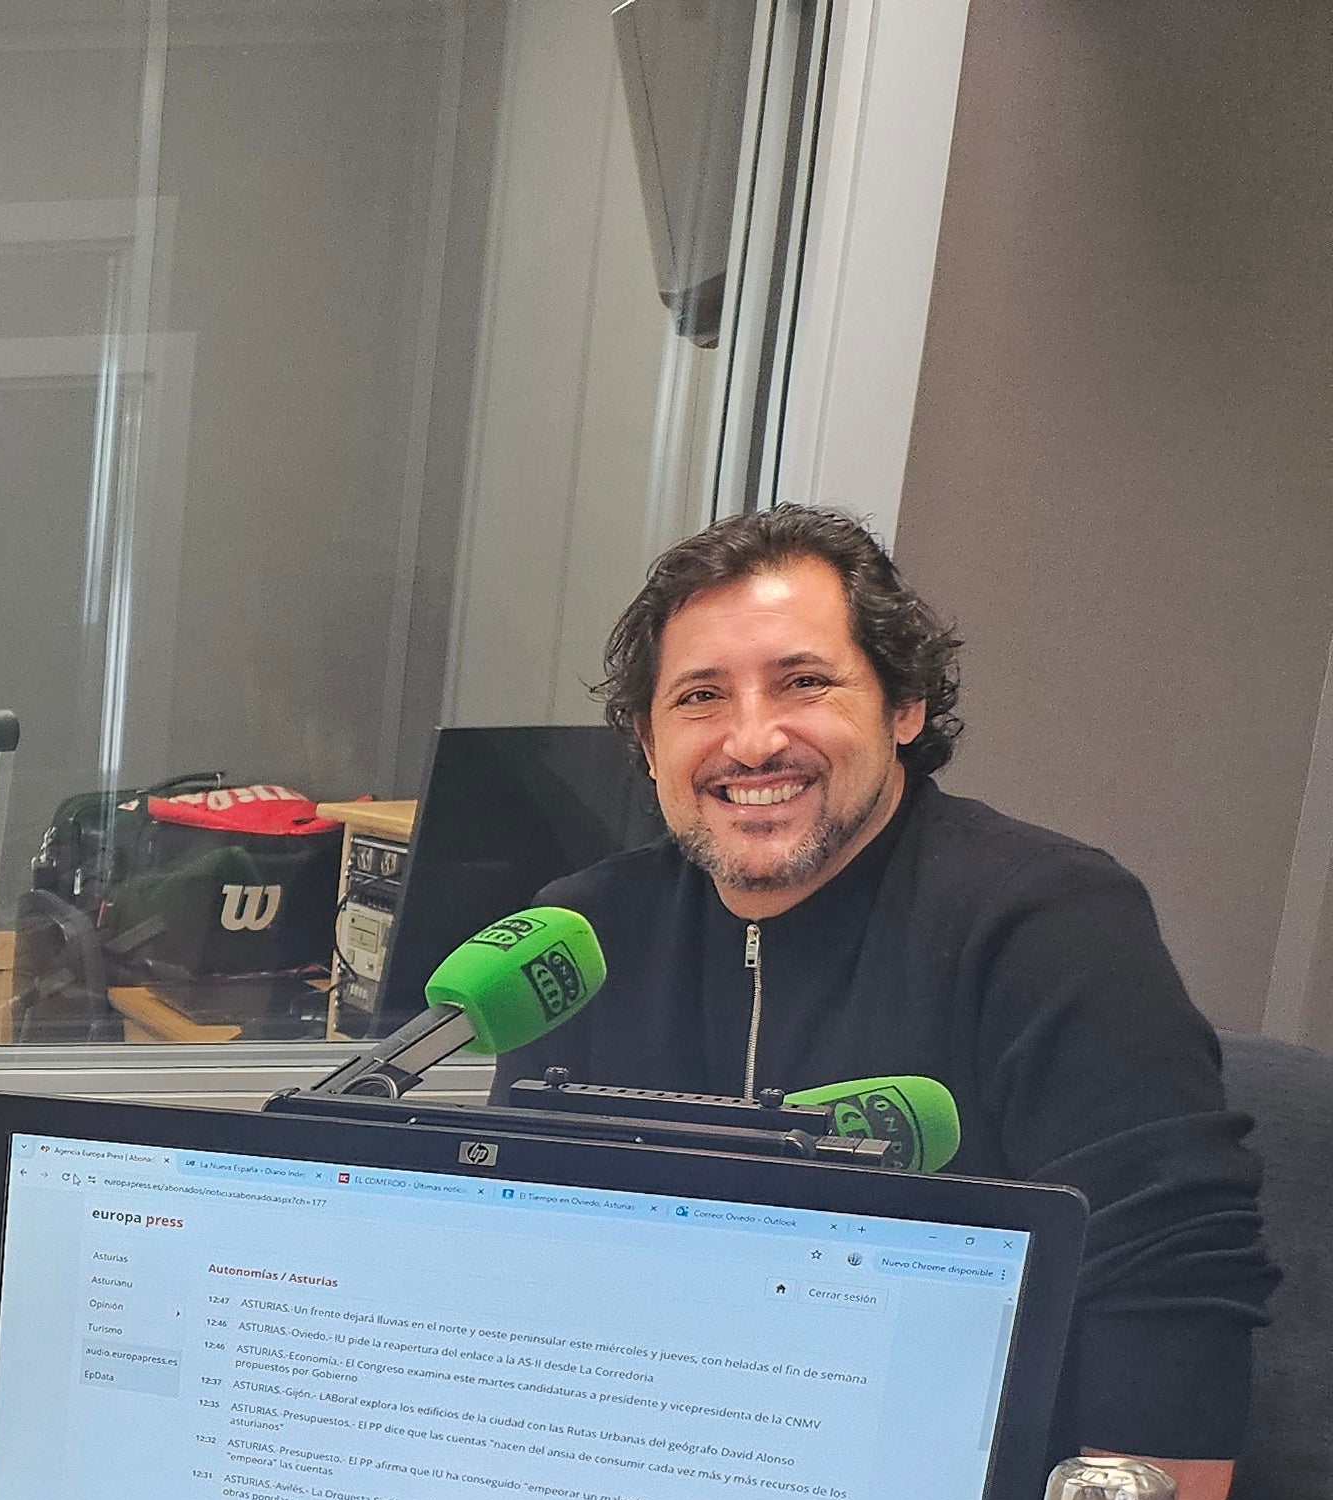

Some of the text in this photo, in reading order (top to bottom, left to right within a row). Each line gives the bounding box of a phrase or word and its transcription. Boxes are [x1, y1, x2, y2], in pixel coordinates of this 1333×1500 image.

[537, 966, 559, 1012] CERO
[91, 1210, 184, 1228] europa press
[92, 1251, 129, 1264] Asturias
[207, 1263, 338, 1288] Autonomías Asturias
[881, 1258, 994, 1277] Nuevo Chrome disponible
[90, 1276, 133, 1289] Asturianu
[89, 1298, 124, 1311] Opinión
[808, 1288, 877, 1305] Cerrar sesión
[88, 1322, 123, 1335] Turismo
[208, 1295, 867, 1385] 12:47 ASTURIAS.-Un frente dejará lluvias en el norte y oeste peninsular este miércoles y jueves, con heladas el fin de semana
[85, 1348, 178, 1367] audio.europapress.es
[84, 1369, 115, 1382] EpData
